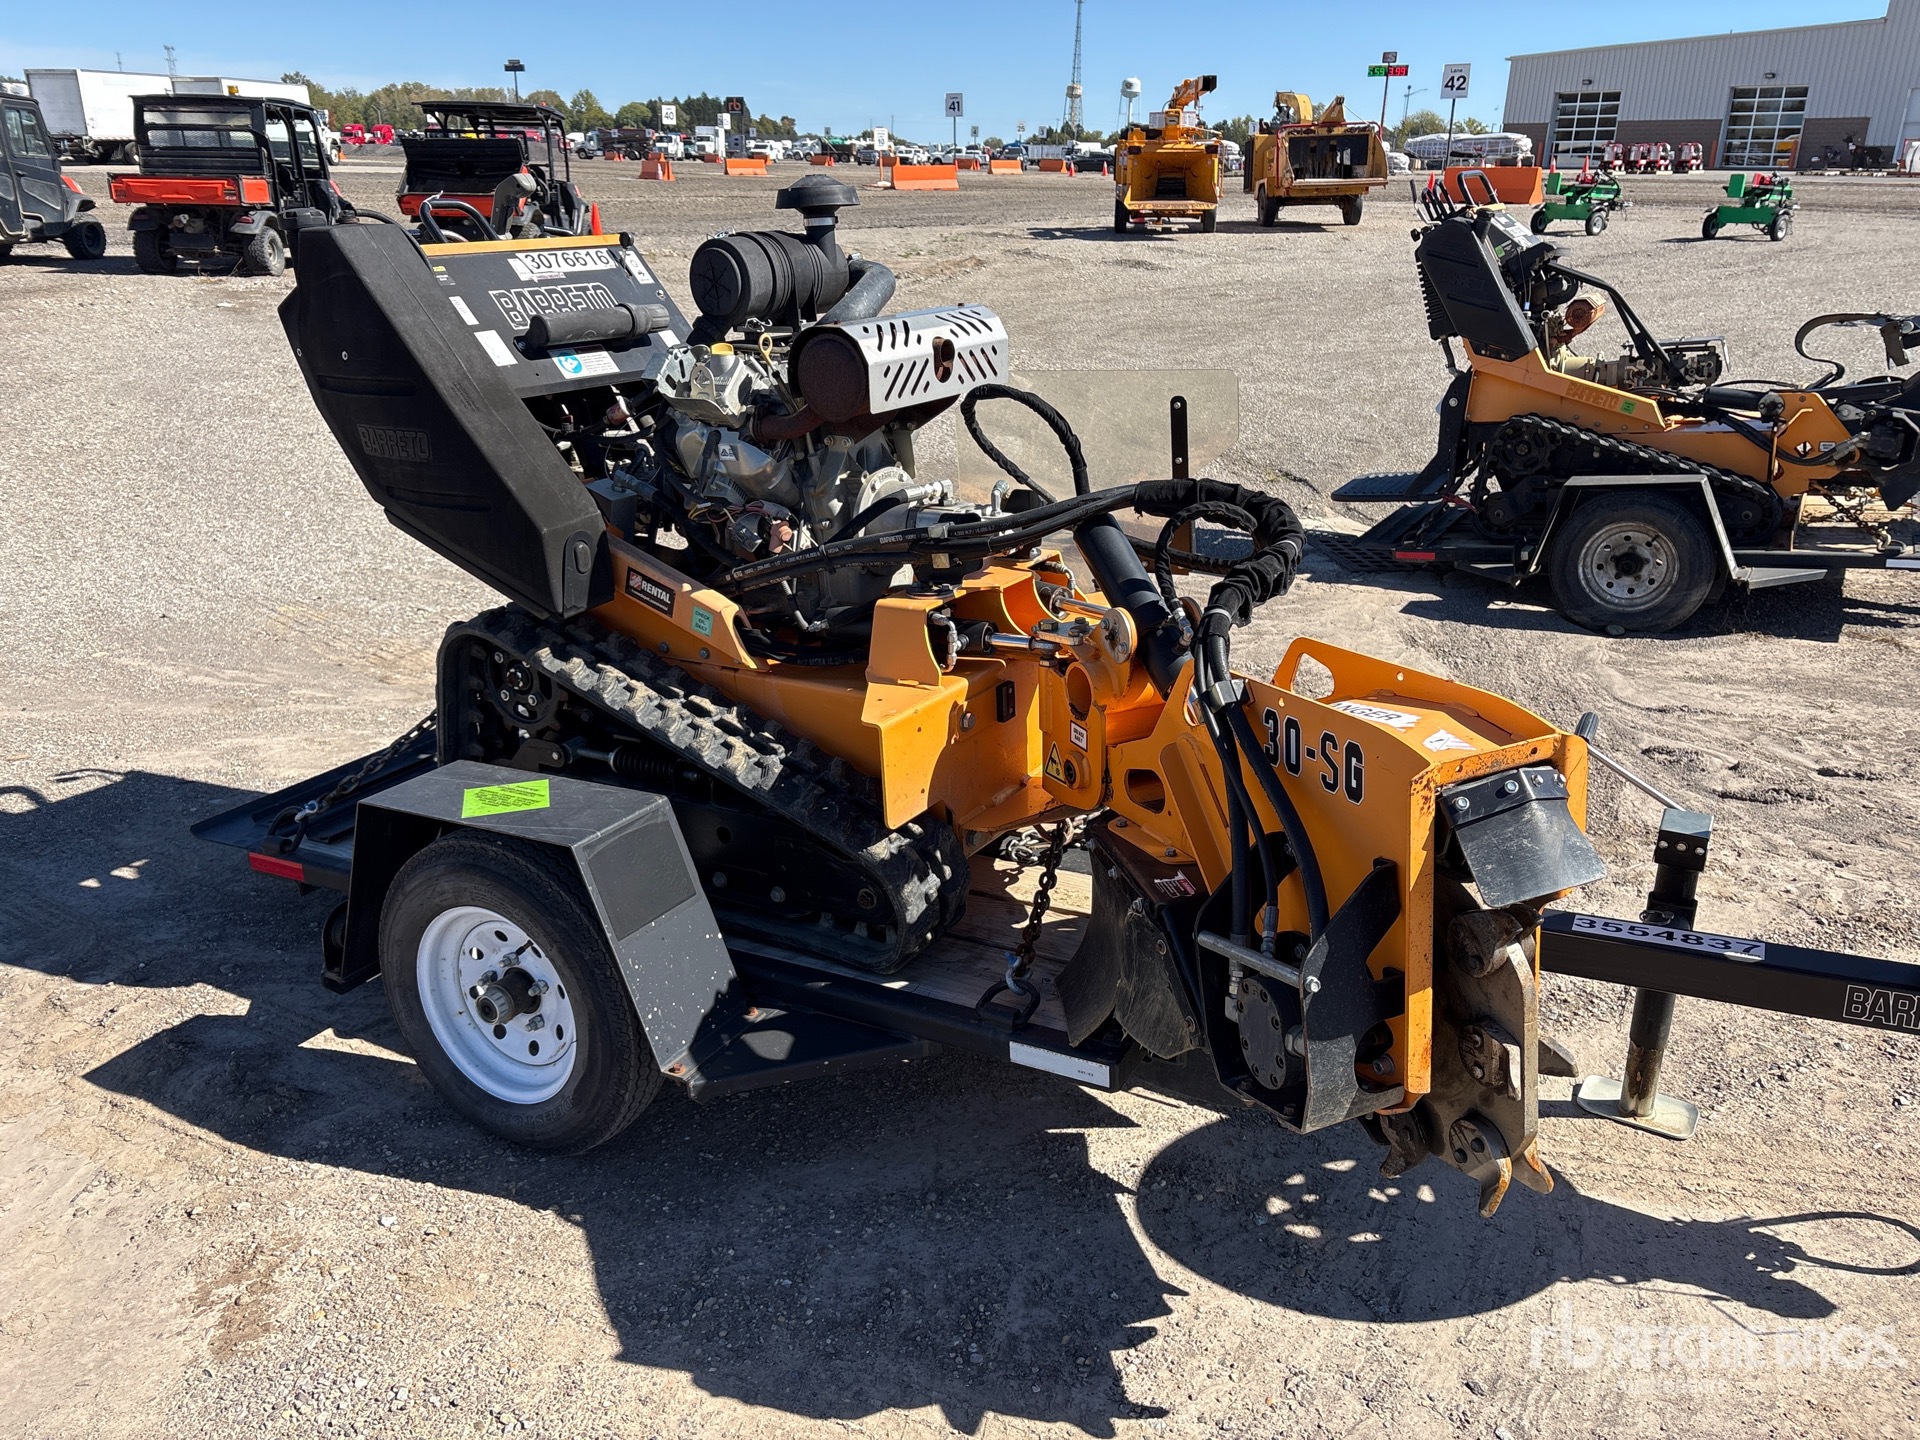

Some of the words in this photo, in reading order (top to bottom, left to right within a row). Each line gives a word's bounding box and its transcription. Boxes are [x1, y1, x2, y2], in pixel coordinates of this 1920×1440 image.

[1444, 75, 1467, 91] 42
[664, 111, 675, 121] 40
[948, 101, 960, 112] 41
[525, 251, 610, 270] 3076616
[357, 424, 432, 462] BARRETO
[879, 535, 903, 544] BARRETO
[641, 581, 671, 604] RENTAL
[1262, 706, 1365, 806] 30-SG
[1574, 916, 1762, 954] 3554837
